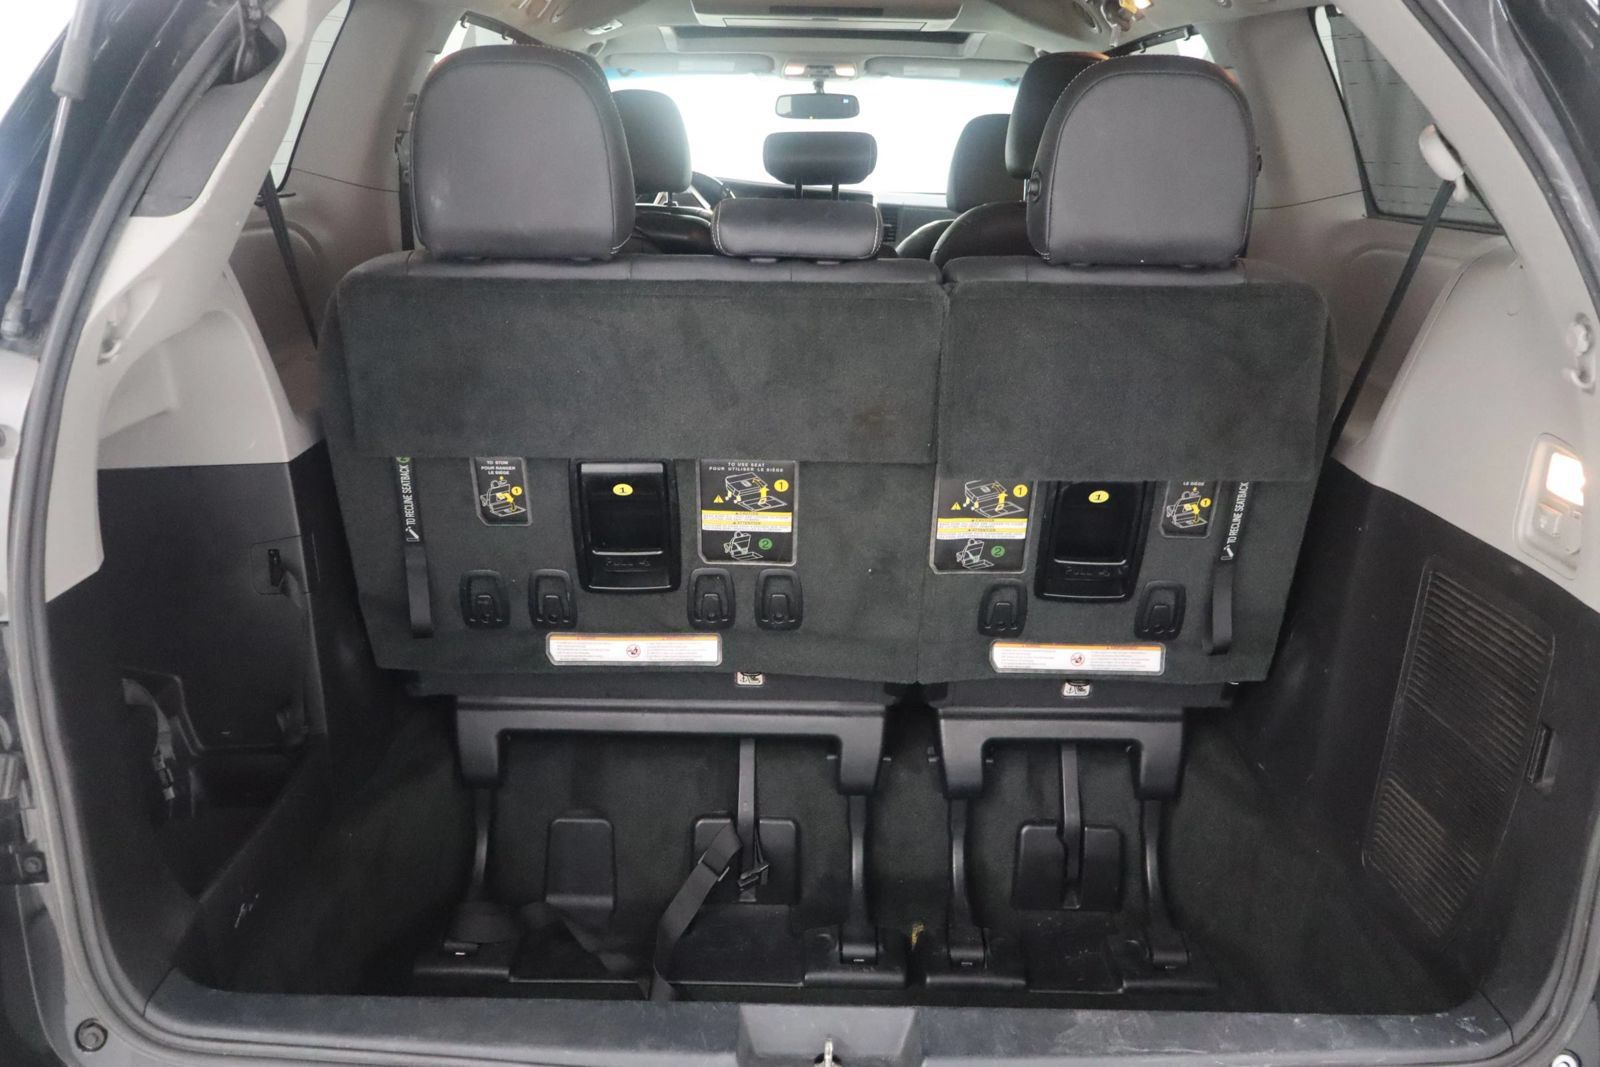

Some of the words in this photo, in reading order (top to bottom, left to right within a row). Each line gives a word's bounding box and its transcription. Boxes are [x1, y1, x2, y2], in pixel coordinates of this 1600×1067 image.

[400, 464, 412, 494] SEATBACK
[402, 494, 415, 518] RECLINE
[1234, 482, 1249, 512] SEATBACK
[1228, 512, 1243, 536] RECLINE
[1227, 536, 1238, 544] TO
